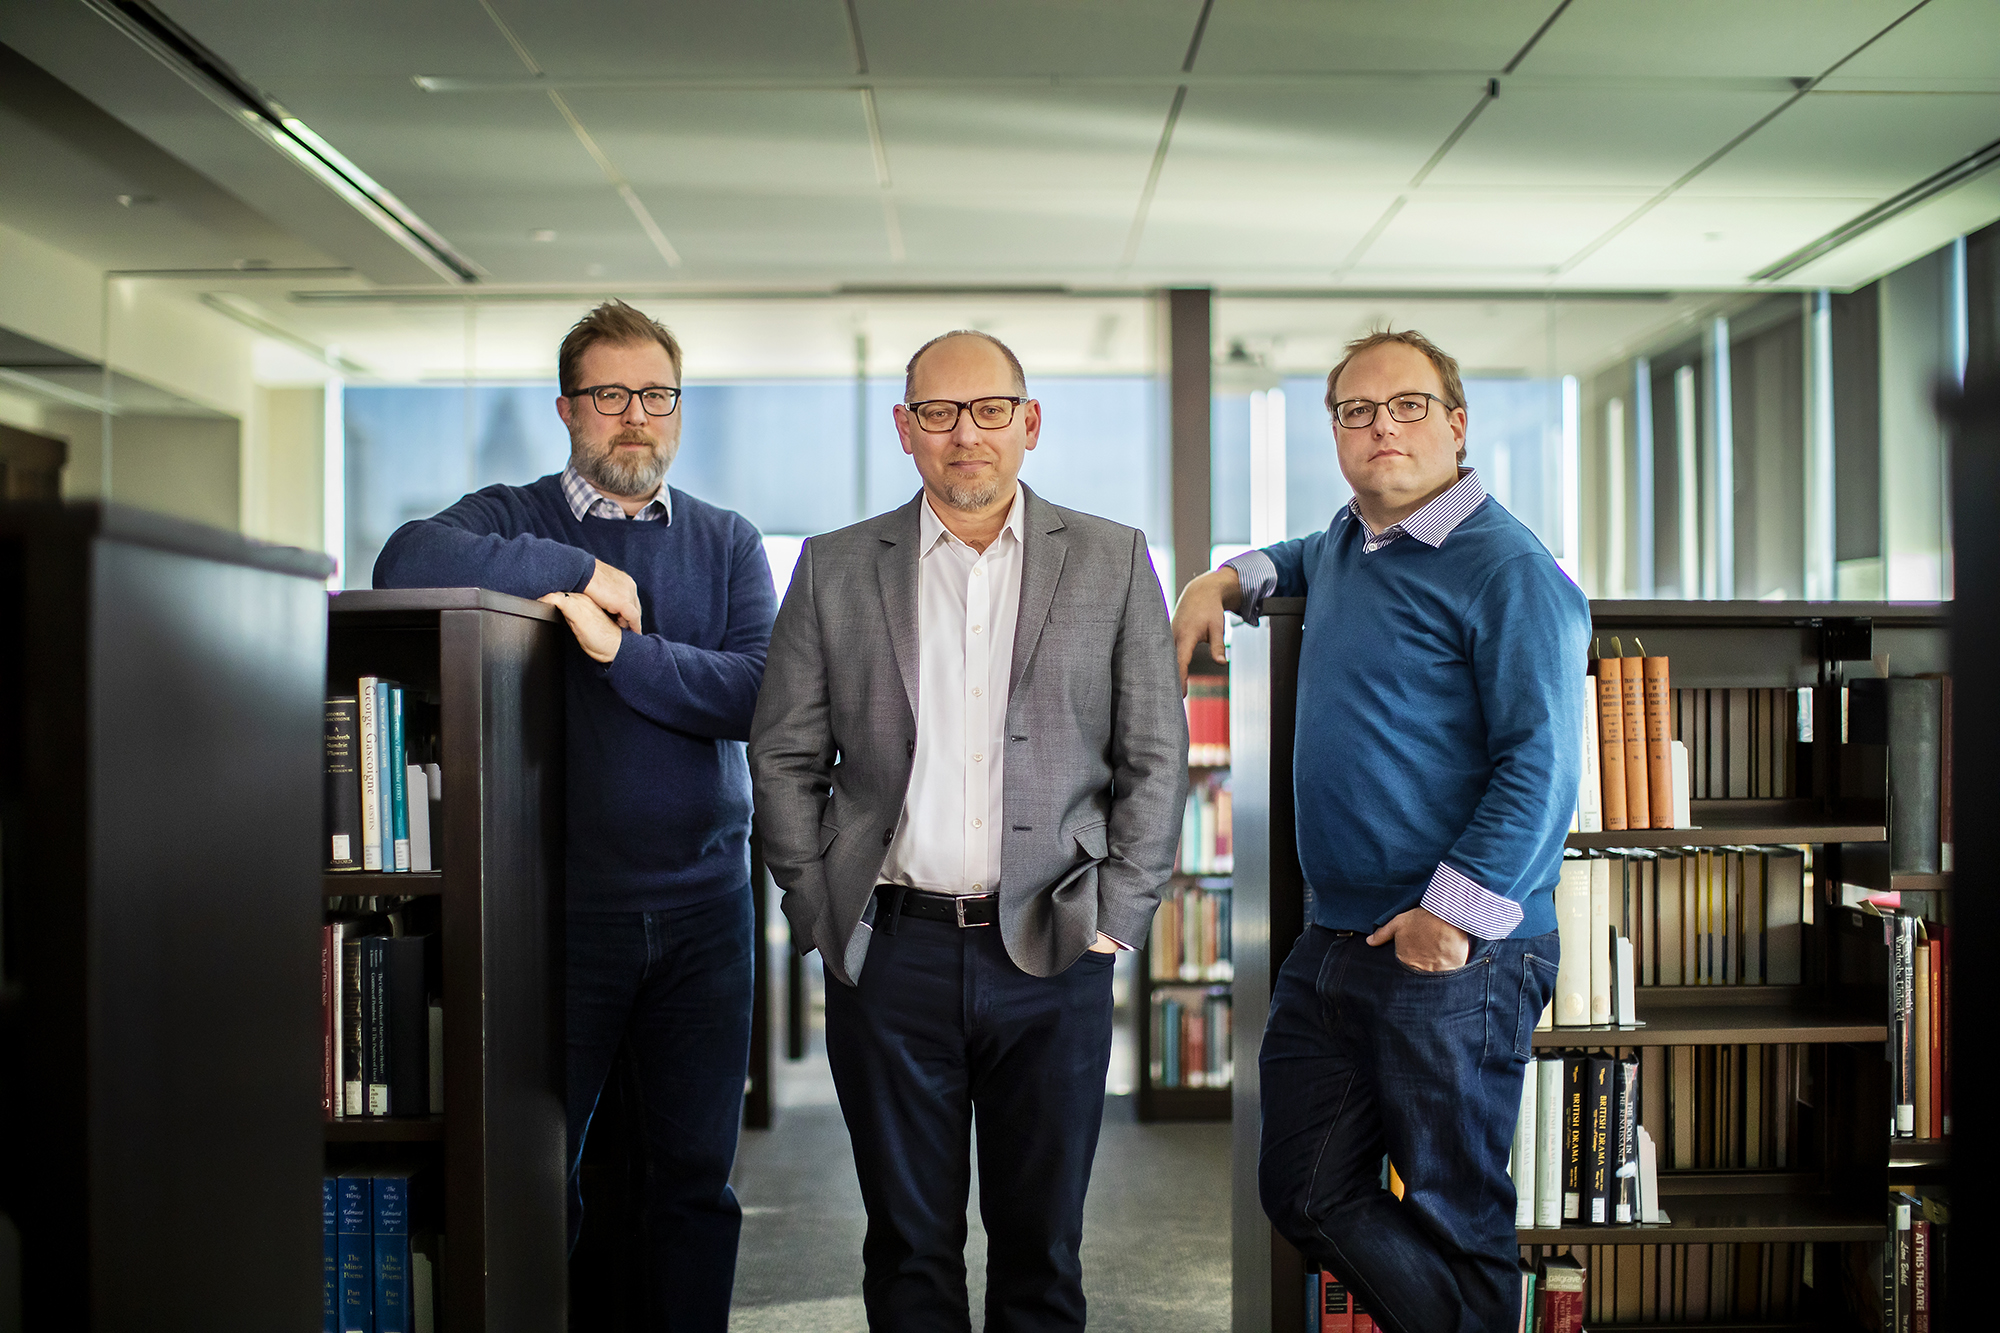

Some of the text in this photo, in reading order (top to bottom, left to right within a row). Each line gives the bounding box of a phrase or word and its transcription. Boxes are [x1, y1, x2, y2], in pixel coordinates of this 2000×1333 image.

[362, 686, 377, 729] George
[362, 733, 379, 796] Gascoigne
[368, 803, 376, 831] AUSTEN
[1895, 935, 1905, 1022] Wardrobe Unlock'd
[1904, 966, 1914, 1015] Elizabeth's
[1549, 1096, 1557, 1130] BRITISH
[1572, 1093, 1580, 1127] BRITISH
[1523, 1096, 1532, 1166] BRITISH DRAMA
[1571, 1130, 1580, 1163] DRAMA
[1598, 1095, 1608, 1166] BRITISH DRAMA
[1618, 1109, 1626, 1164] RENAISSANCE
[1548, 1133, 1557, 1166] DRAMA
[1626, 1145, 1632, 1154] IN
[343, 1271, 363, 1279] Poems
[347, 1254, 359, 1262] The
[1900, 1262, 1910, 1287] Bakst
[1916, 1233, 1926, 1311] AT THIS THEATRE
[347, 1289, 360, 1297] Part
[381, 1272, 402, 1280] Poems
[1549, 1274, 1582, 1285] palgrave
[1885, 1272, 1893, 1328] TITUS
